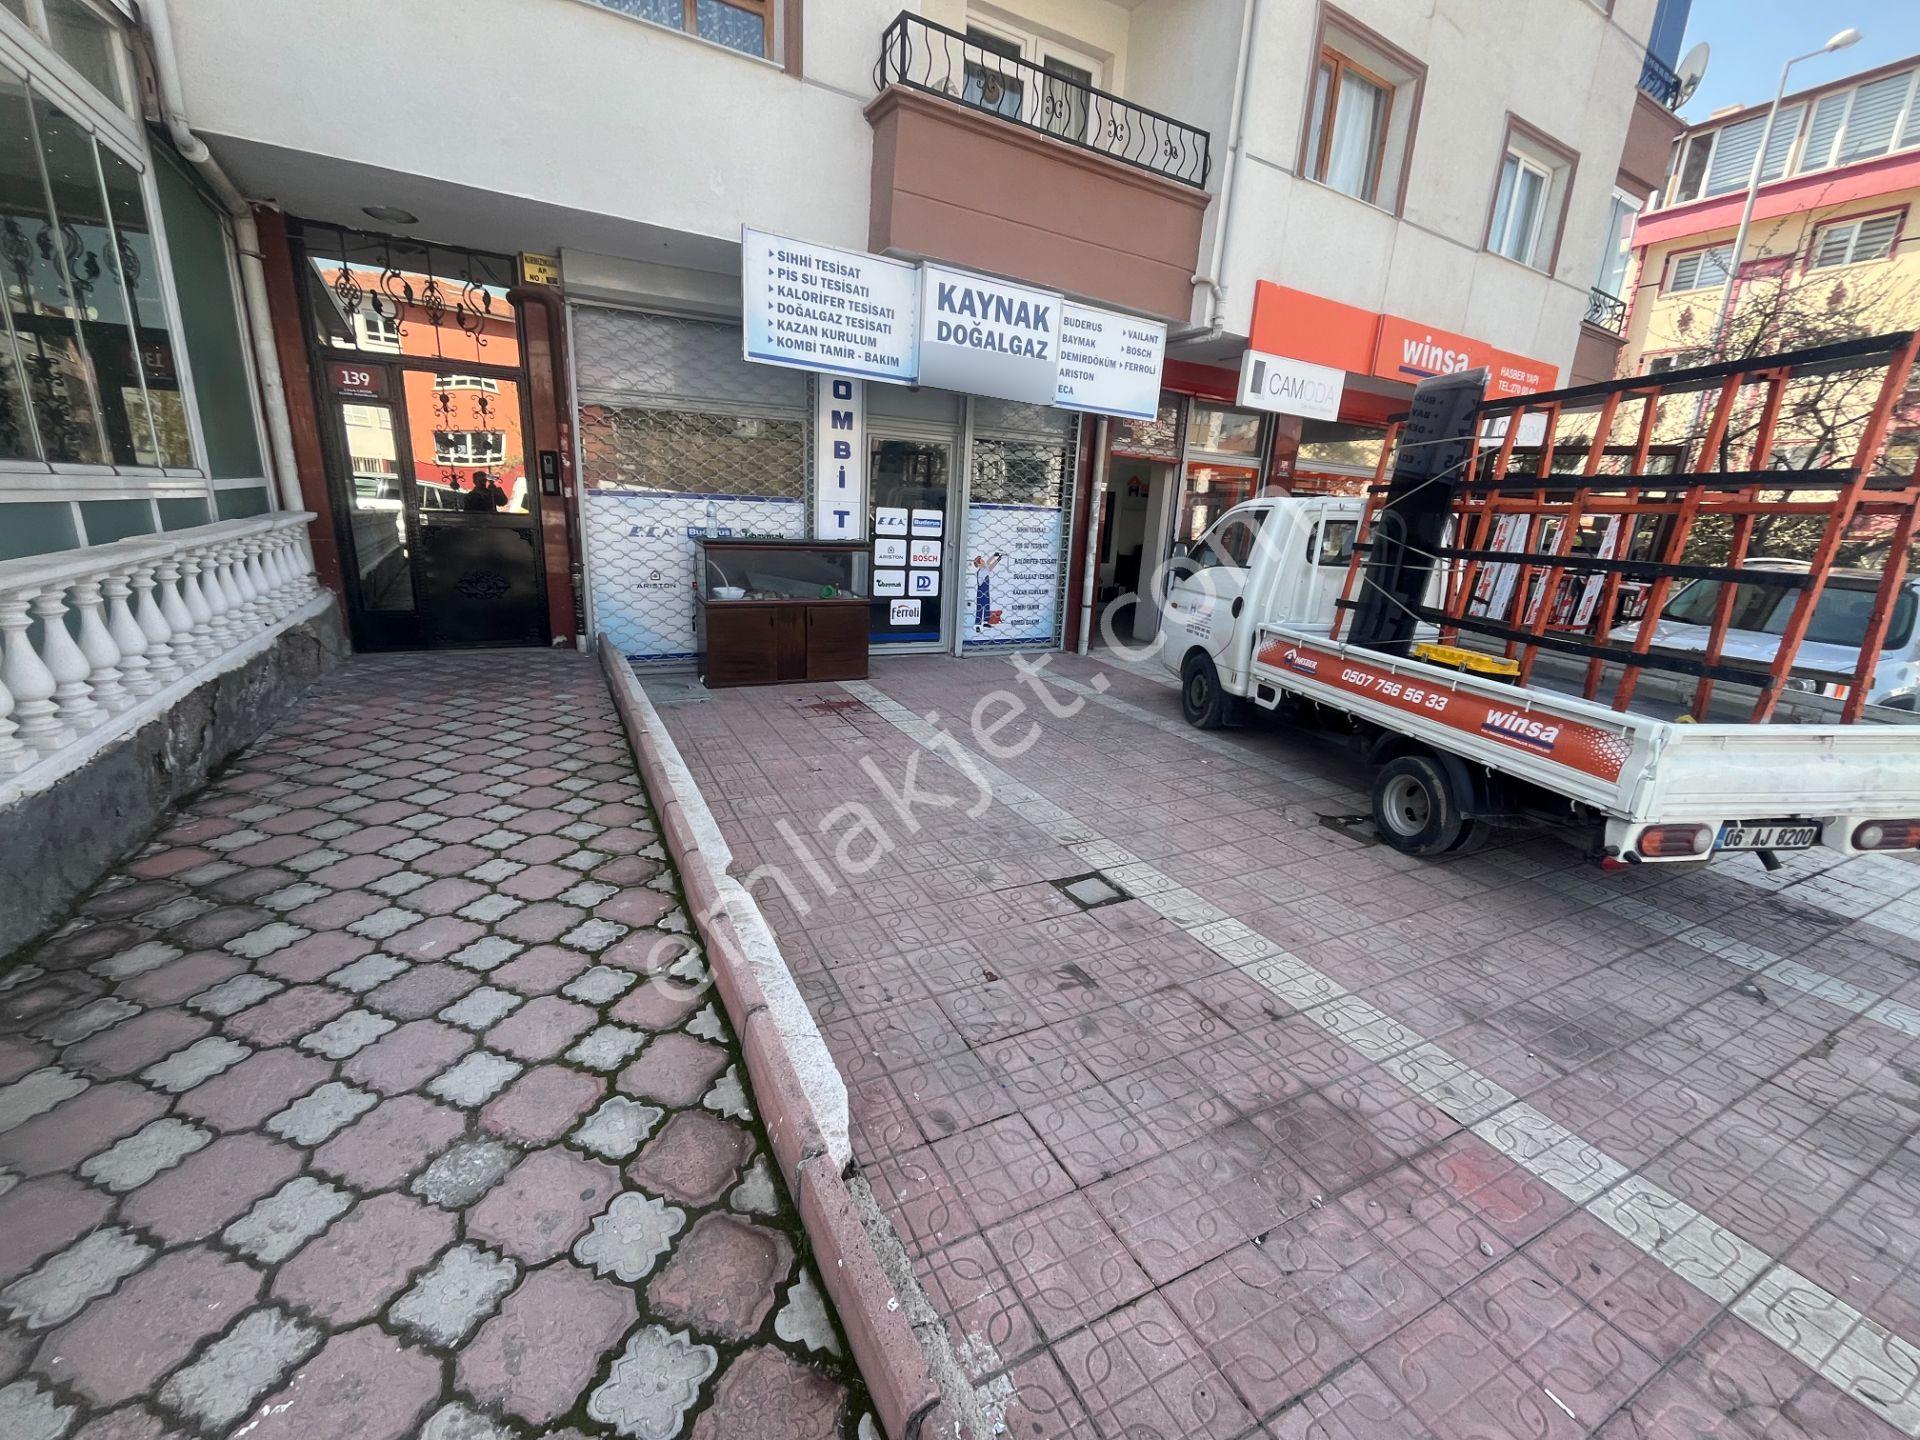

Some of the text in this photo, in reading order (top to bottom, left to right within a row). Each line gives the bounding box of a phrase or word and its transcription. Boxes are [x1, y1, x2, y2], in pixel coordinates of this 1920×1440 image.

[777, 250, 861, 279] SIHHİ TESİSAT
[777, 267, 870, 298] PİS SU TESİSATI
[777, 285, 895, 320] KALORİFER TESİSATI
[937, 282, 1050, 333] KAYNAK
[777, 302, 892, 335] DOĞALGAZ TESİSATI
[1063, 316, 1103, 333] BUDERUS
[777, 319, 877, 348] KAZAN KURULUM
[937, 320, 1048, 361] DOĞALGAZ
[1062, 333, 1097, 348] BAYMAK
[1128, 329, 1159, 344] VAILANT
[777, 336, 816, 353] KOMBİ
[819, 343, 855, 360] TAMİR
[864, 352, 900, 368] BAKIM
[1125, 346, 1152, 358] BOSCH
[1403, 335, 1470, 374] winsa
[342, 370, 370, 386] 139
[1059, 367, 1095, 381] ARISTON
[1269, 372, 1334, 405] CAMODA
[1058, 384, 1074, 395] ECA
[831, 379, 854, 489] OMBİ
[912, 554, 938, 562] BOSCH
[892, 606, 920, 619] Ferroli
[1341, 668, 1448, 712] 0507 756 56 33
[1486, 709, 1559, 743] winsa
[1724, 828, 1814, 847] 06 AJ 8200
